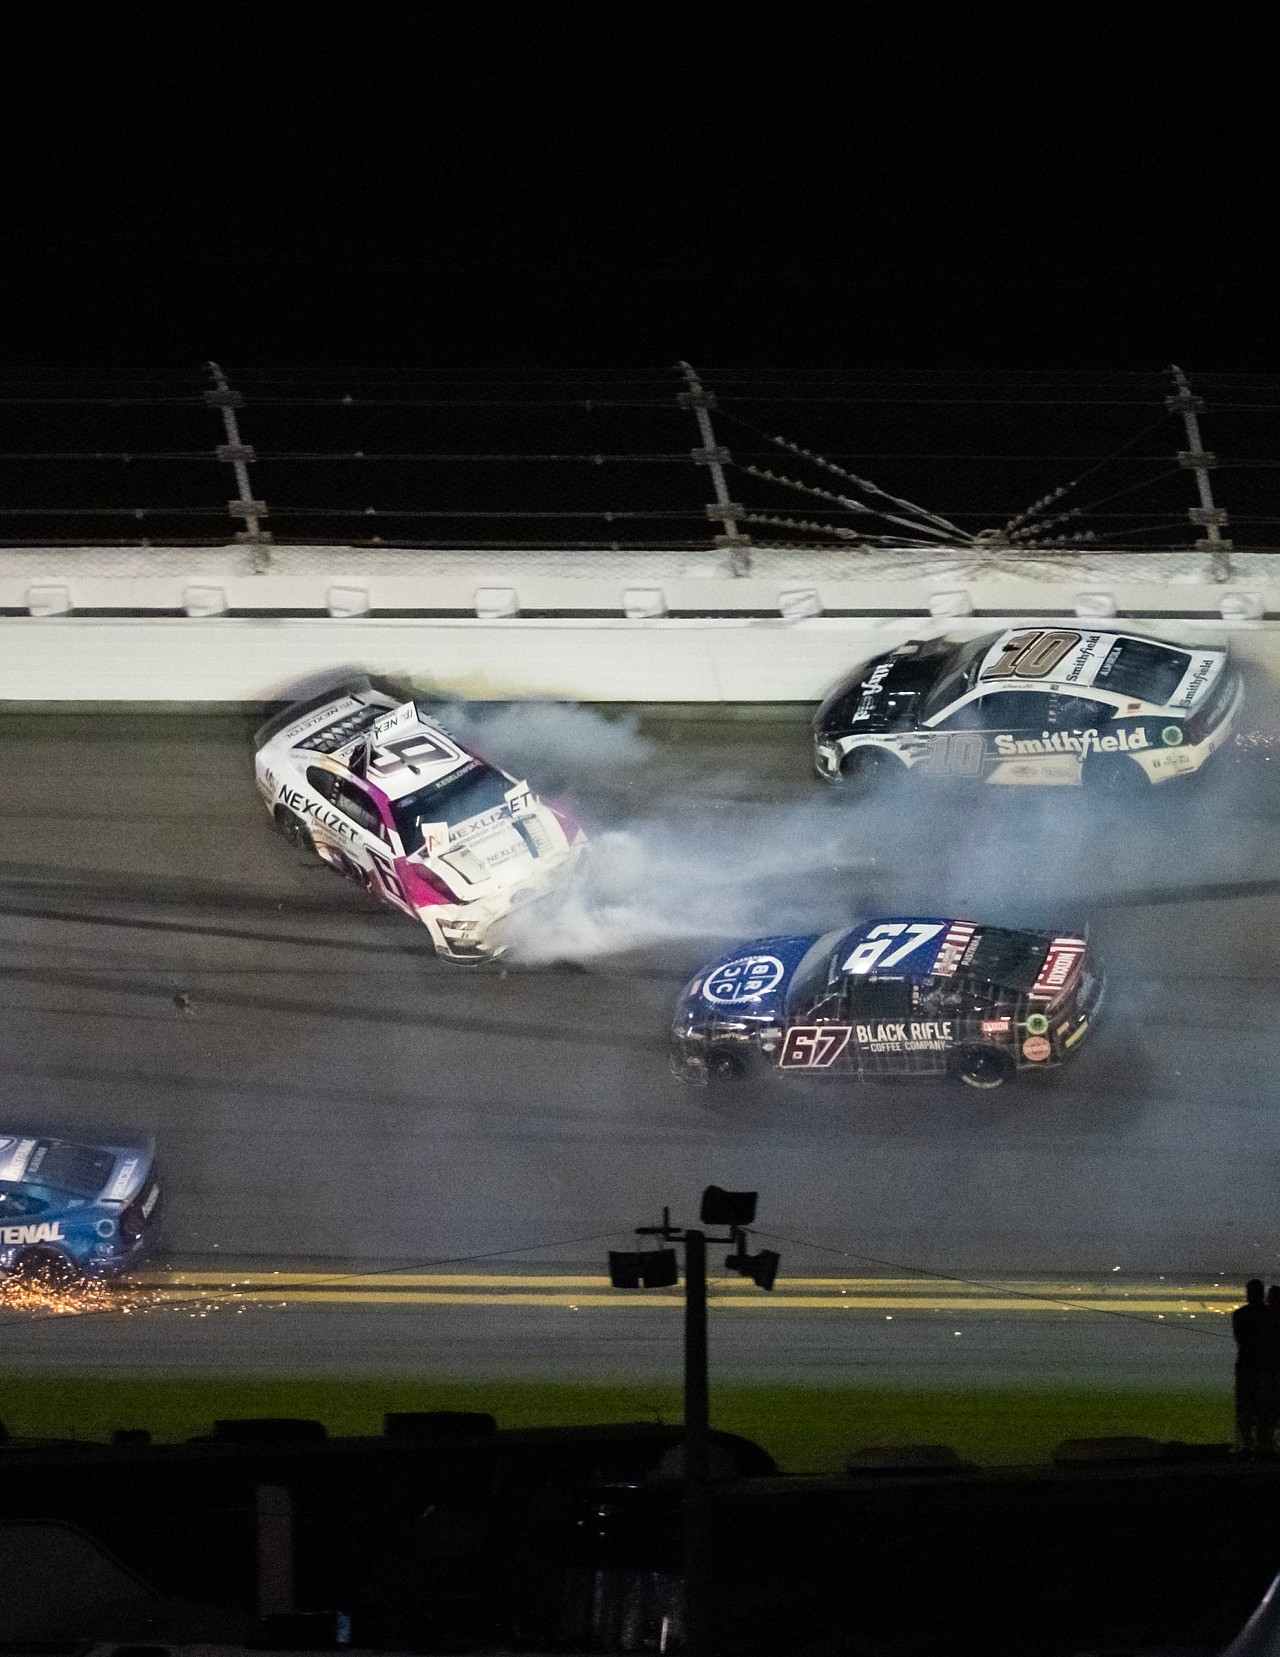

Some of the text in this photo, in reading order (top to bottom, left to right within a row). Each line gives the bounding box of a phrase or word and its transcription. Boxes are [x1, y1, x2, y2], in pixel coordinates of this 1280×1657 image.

[980, 631, 1082, 679] 10
[1066, 634, 1101, 682] Smithfield
[1180, 659, 1214, 707] Smithfield
[921, 734, 988, 778] 10
[994, 728, 1151, 764] Smithfield
[278, 783, 359, 845] NEXLIZET
[842, 923, 946, 975] 67
[778, 1026, 853, 1068] 67
[856, 1021, 954, 1044] BLACK RIFLE
[870, 1040, 947, 1053] COFFEE COMPANY
